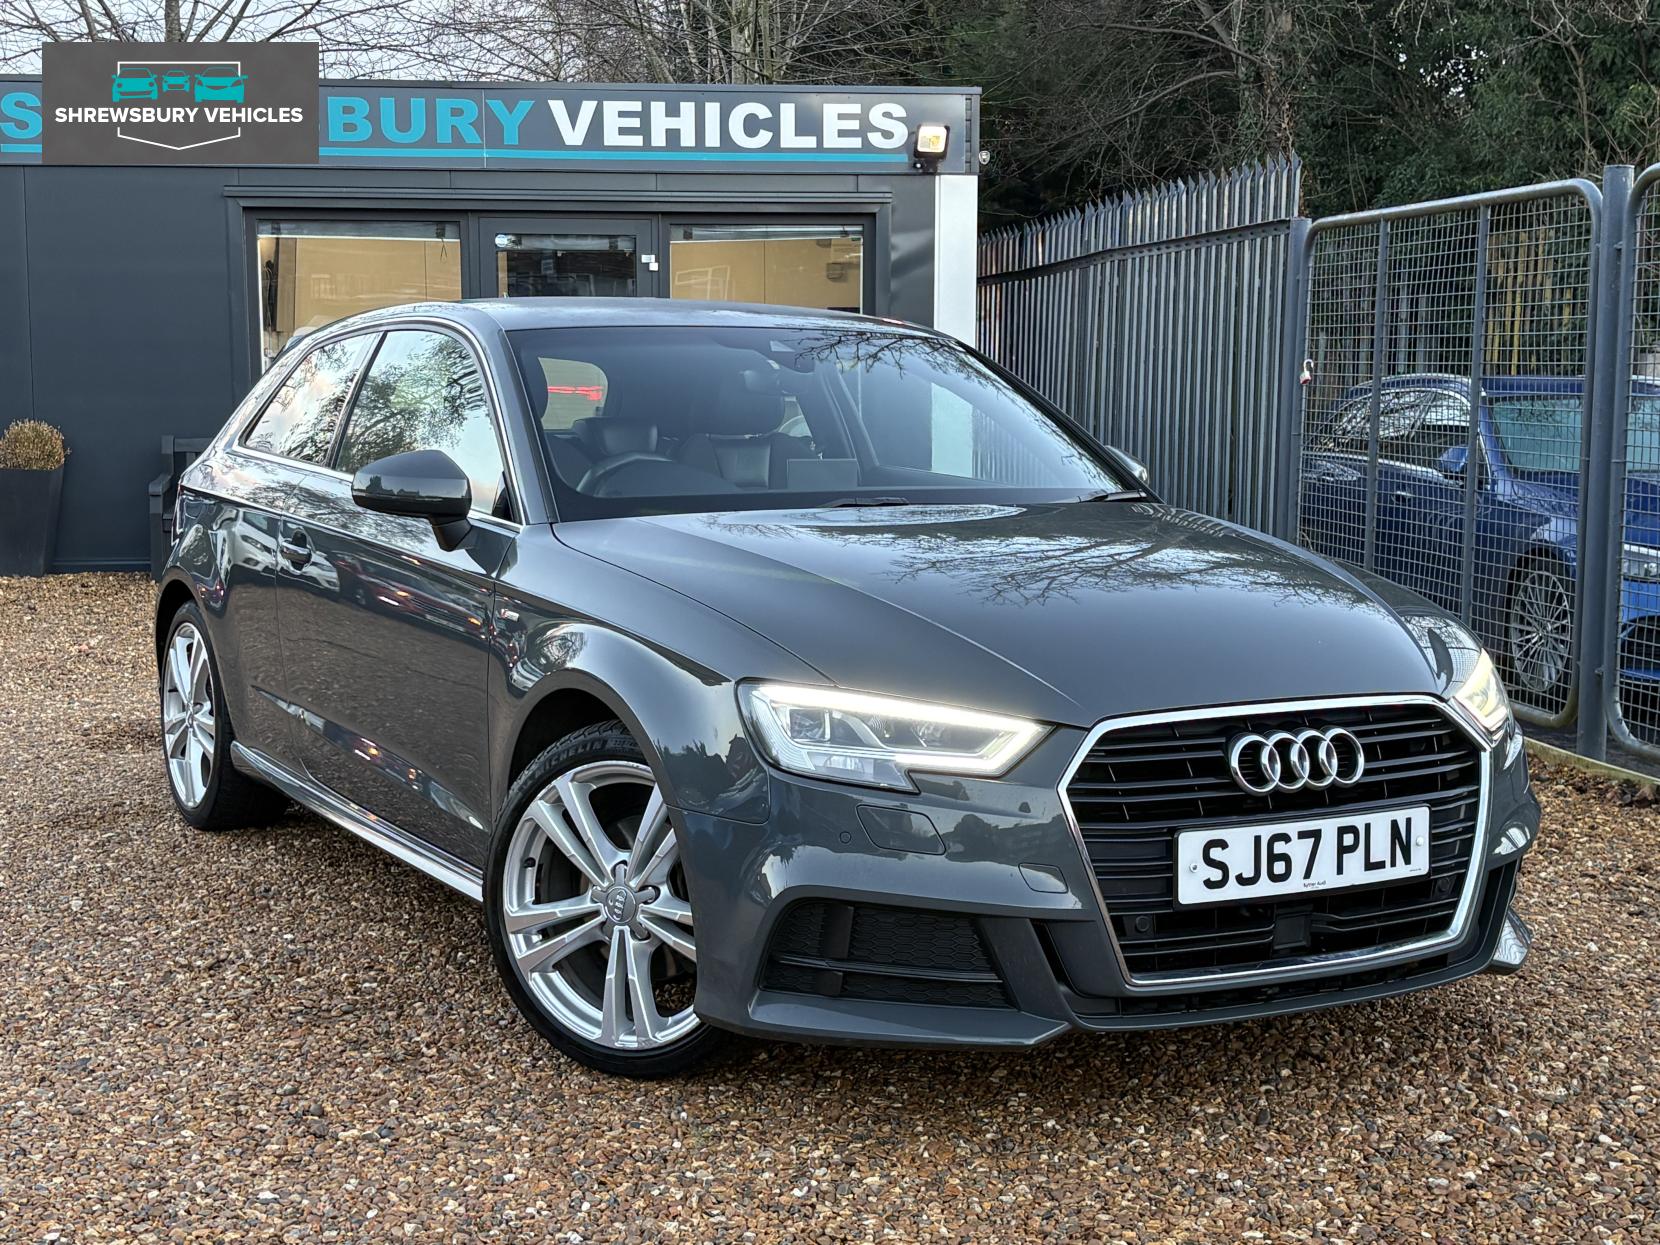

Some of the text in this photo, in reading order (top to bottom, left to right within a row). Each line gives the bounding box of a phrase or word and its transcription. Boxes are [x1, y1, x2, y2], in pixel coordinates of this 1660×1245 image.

[548, 98, 909, 150] VEHICLES
[1202, 817, 1412, 890] SJ67 PLN
